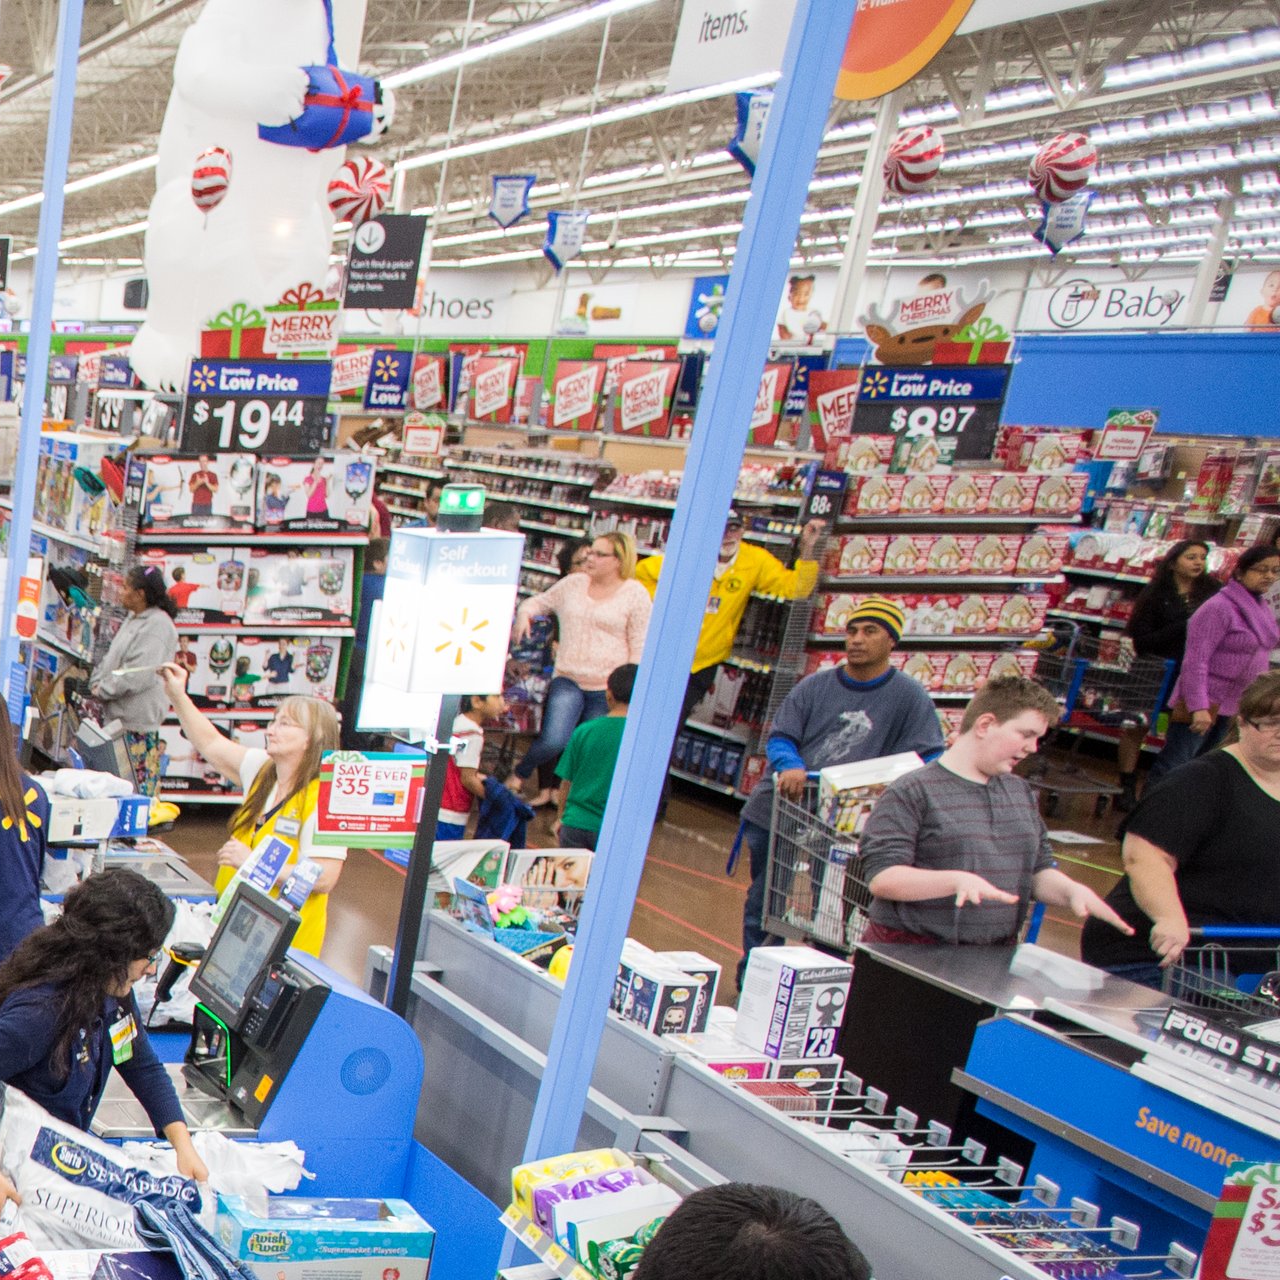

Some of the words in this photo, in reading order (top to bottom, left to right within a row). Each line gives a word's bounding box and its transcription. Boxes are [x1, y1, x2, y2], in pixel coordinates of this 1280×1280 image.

[698, 11, 749, 43] items.
[900, 292, 954, 313] MERRY
[1105, 289, 1186, 325] Baby
[271, 315, 336, 332] MERRY
[900, 306, 952, 323] CHRISTMAS
[270, 331, 333, 344] CHRISTMAS
[220, 373, 255, 391] Low
[257, 373, 299, 391] Price
[558, 375, 592, 398] MERRY
[625, 376, 664, 401] MERRY
[890, 379, 925, 397] Low
[928, 379, 973, 397] Price
[370, 390, 402, 405] Low
[439, 545, 469, 561] Self
[439, 562, 508, 579] Checkout
[338, 764, 372, 777] SAVE
[375, 771, 408, 781] EVER
[336, 777, 370, 796] $35
[799, 967, 852, 981] Fabrikations
[807, 1029, 837, 1058] 23
[1163, 1013, 1239, 1056] POGO
[1135, 1106, 1181, 1144] Save
[59, 1147, 83, 1169] Serta
[32, 1187, 137, 1236] SUPERIOR
